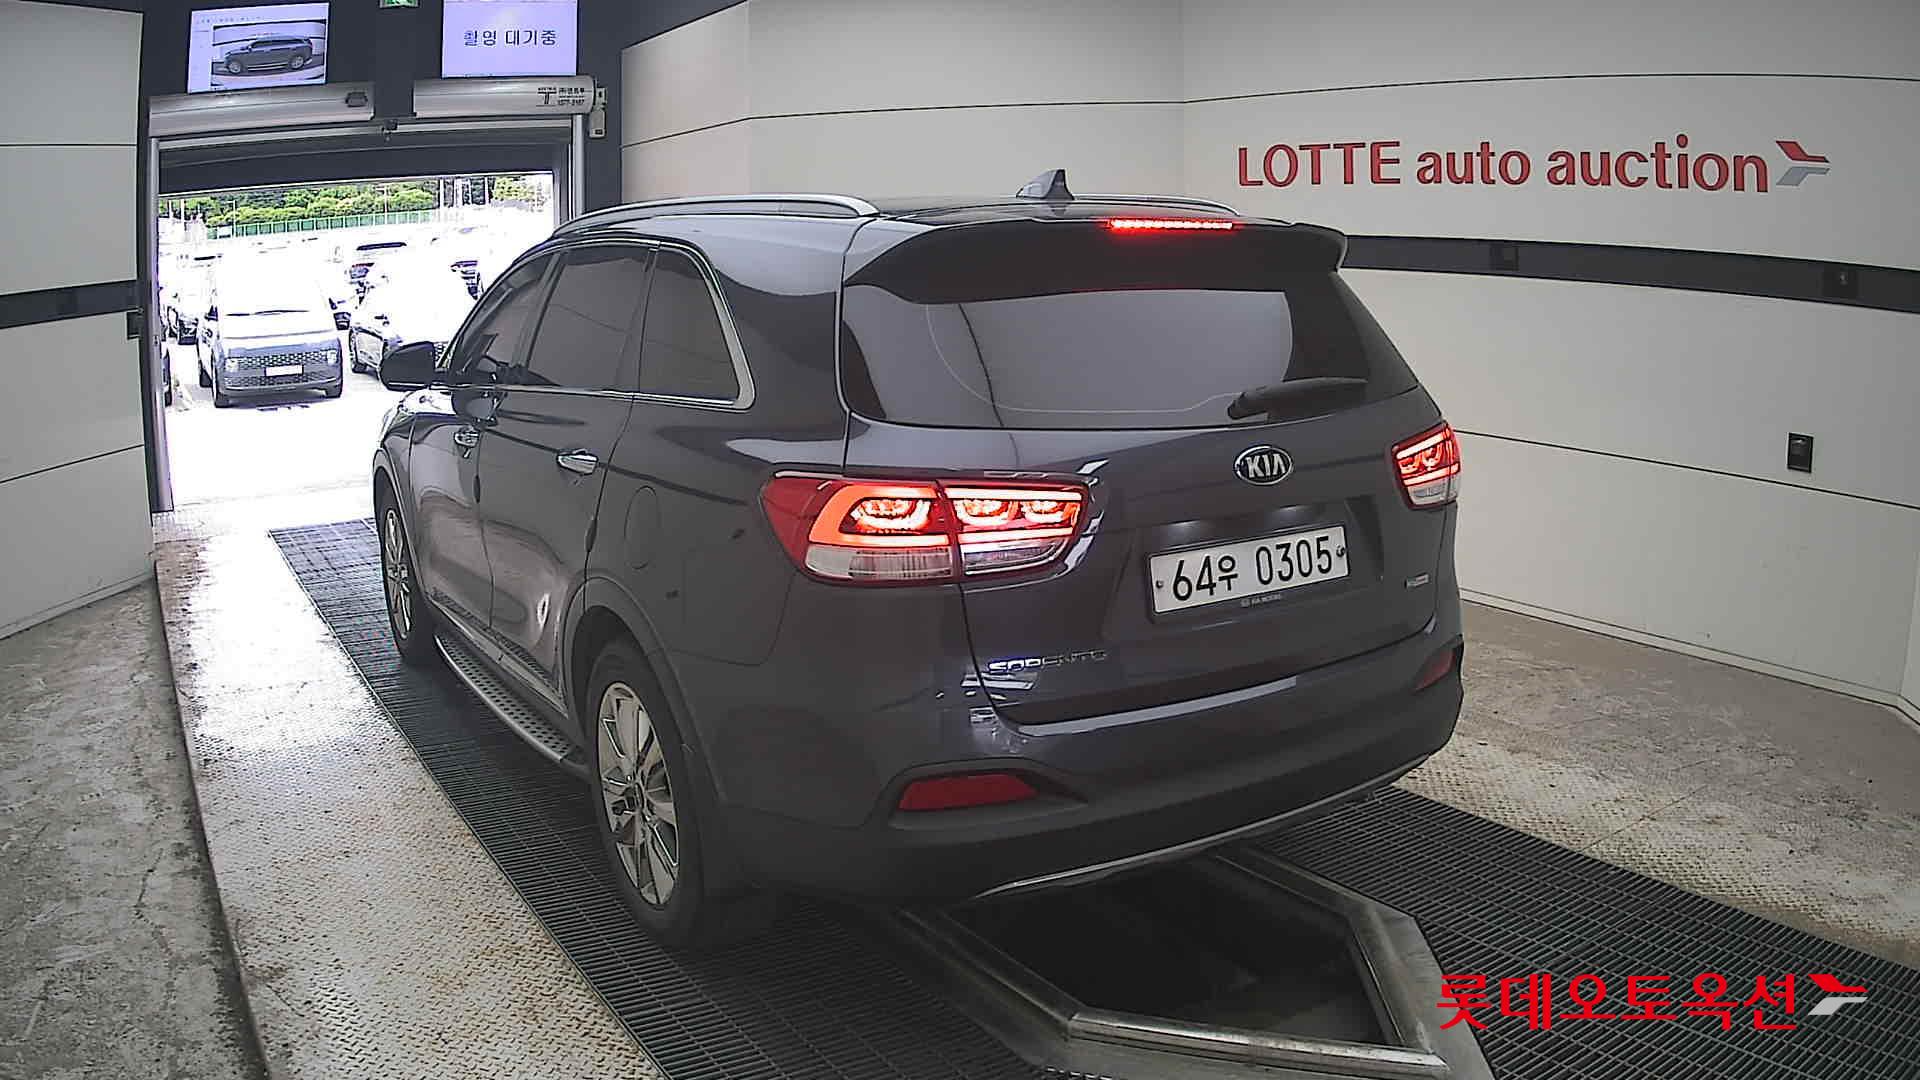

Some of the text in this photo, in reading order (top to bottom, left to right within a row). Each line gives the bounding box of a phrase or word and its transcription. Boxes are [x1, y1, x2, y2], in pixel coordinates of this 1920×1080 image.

[505, 30, 557, 46] 대기중
[1237, 133, 1769, 193] LOTTE auto auction
[1245, 453, 1286, 478] KIA
[1172, 535, 1333, 601] 64우 0305
